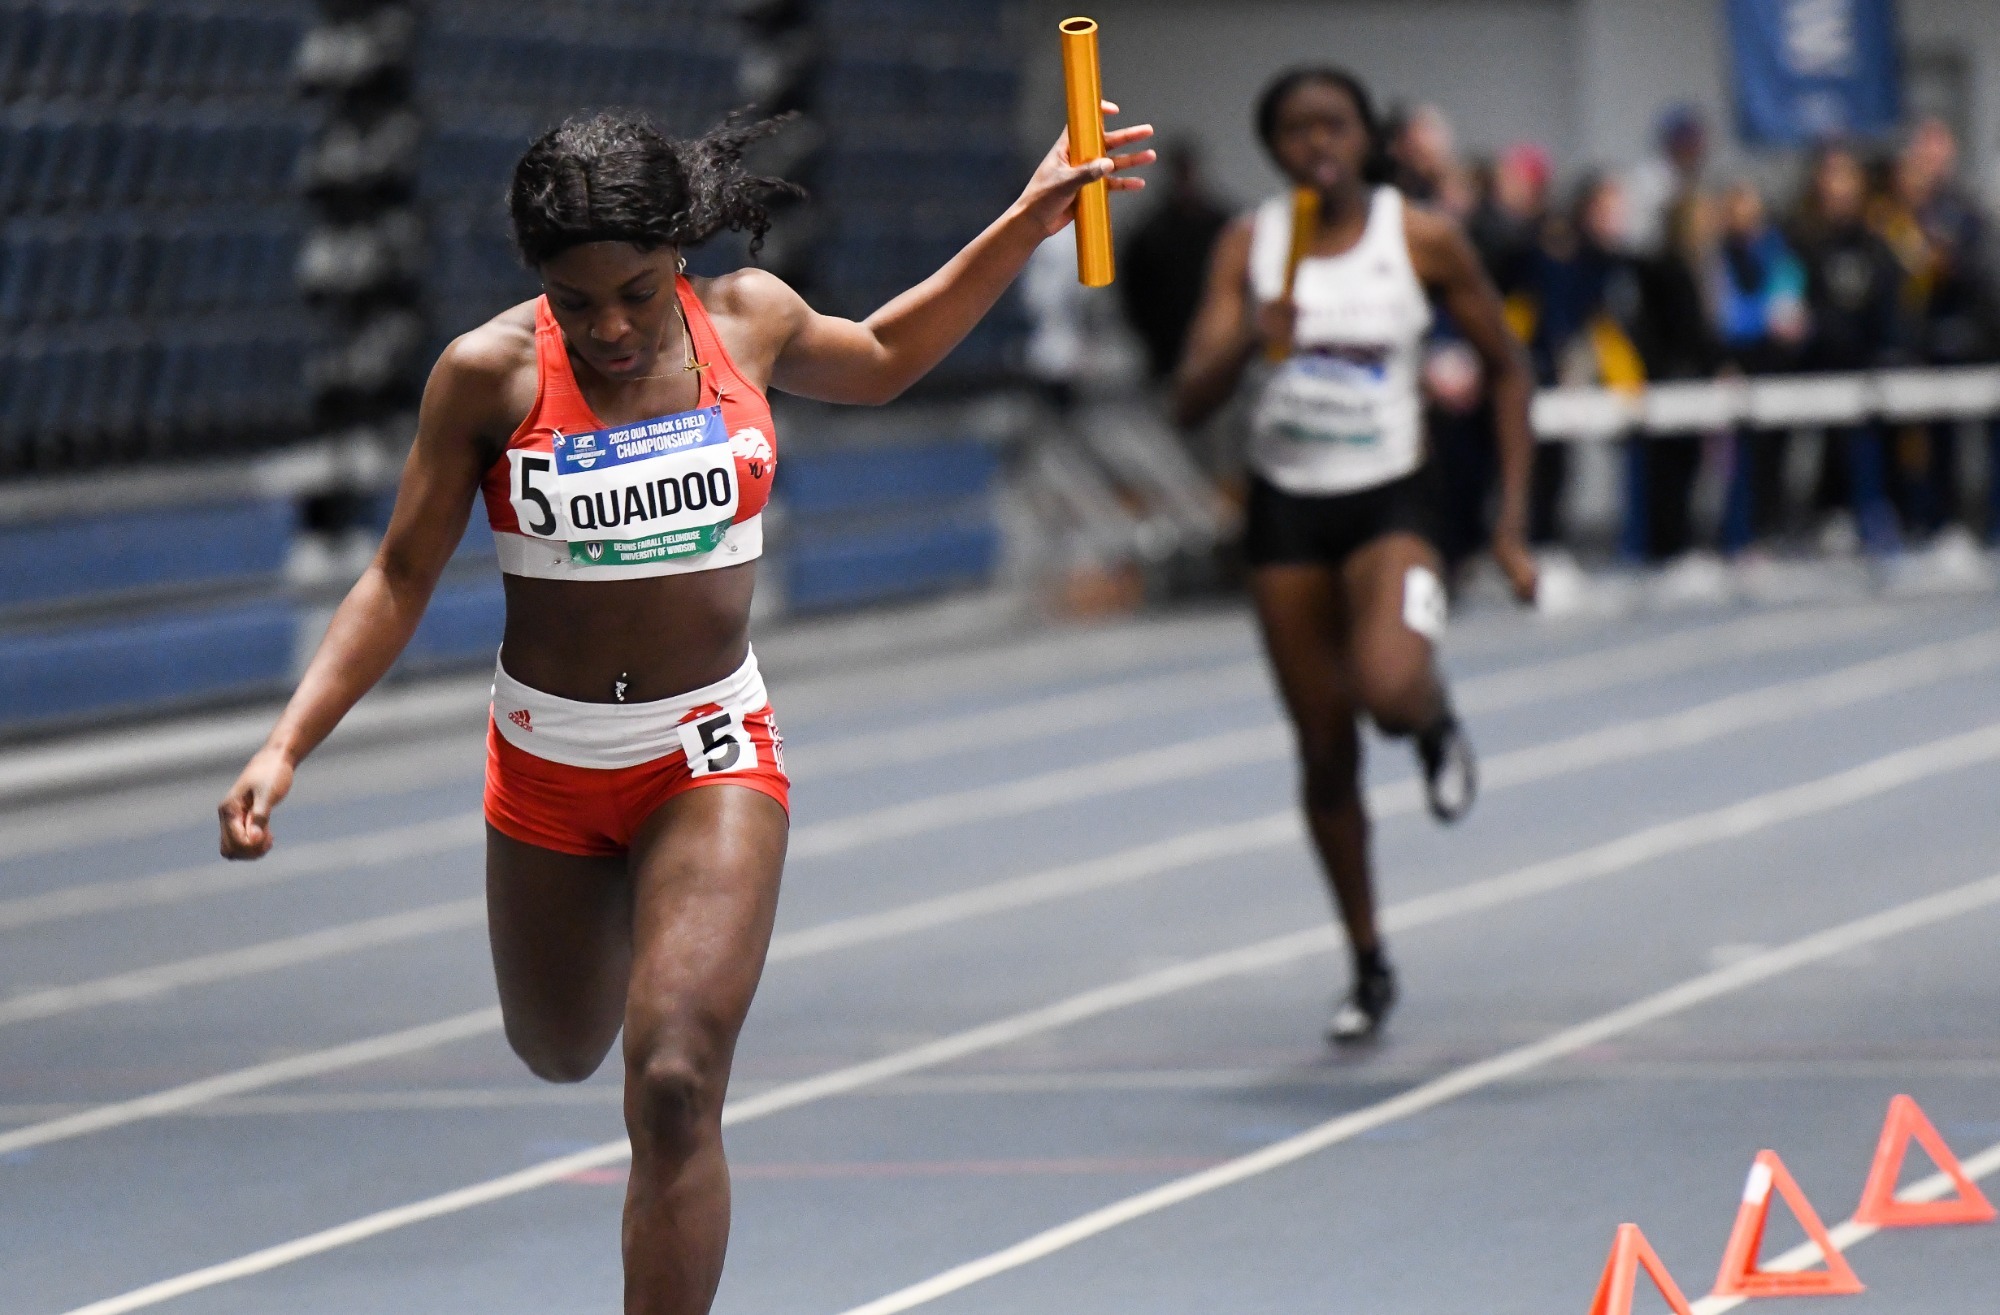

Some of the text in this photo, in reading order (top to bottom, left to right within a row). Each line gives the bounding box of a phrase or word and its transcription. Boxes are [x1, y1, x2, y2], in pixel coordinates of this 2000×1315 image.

[608, 414, 706, 445] 2023 OUA TRACK & FIELD
[616, 429, 703, 459] CHAMPIONSHIPS
[748, 462, 764, 479] YU
[521, 456, 557, 536] 5
[570, 467, 731, 529] QUAIDOO
[614, 530, 701, 551] DENNIS FAIRALL FIELDHOUSE
[620, 542, 697, 562] UNIVERSITY OF WINDSOR
[508, 712, 533, 732] adidas
[697, 713, 740, 772] 5
